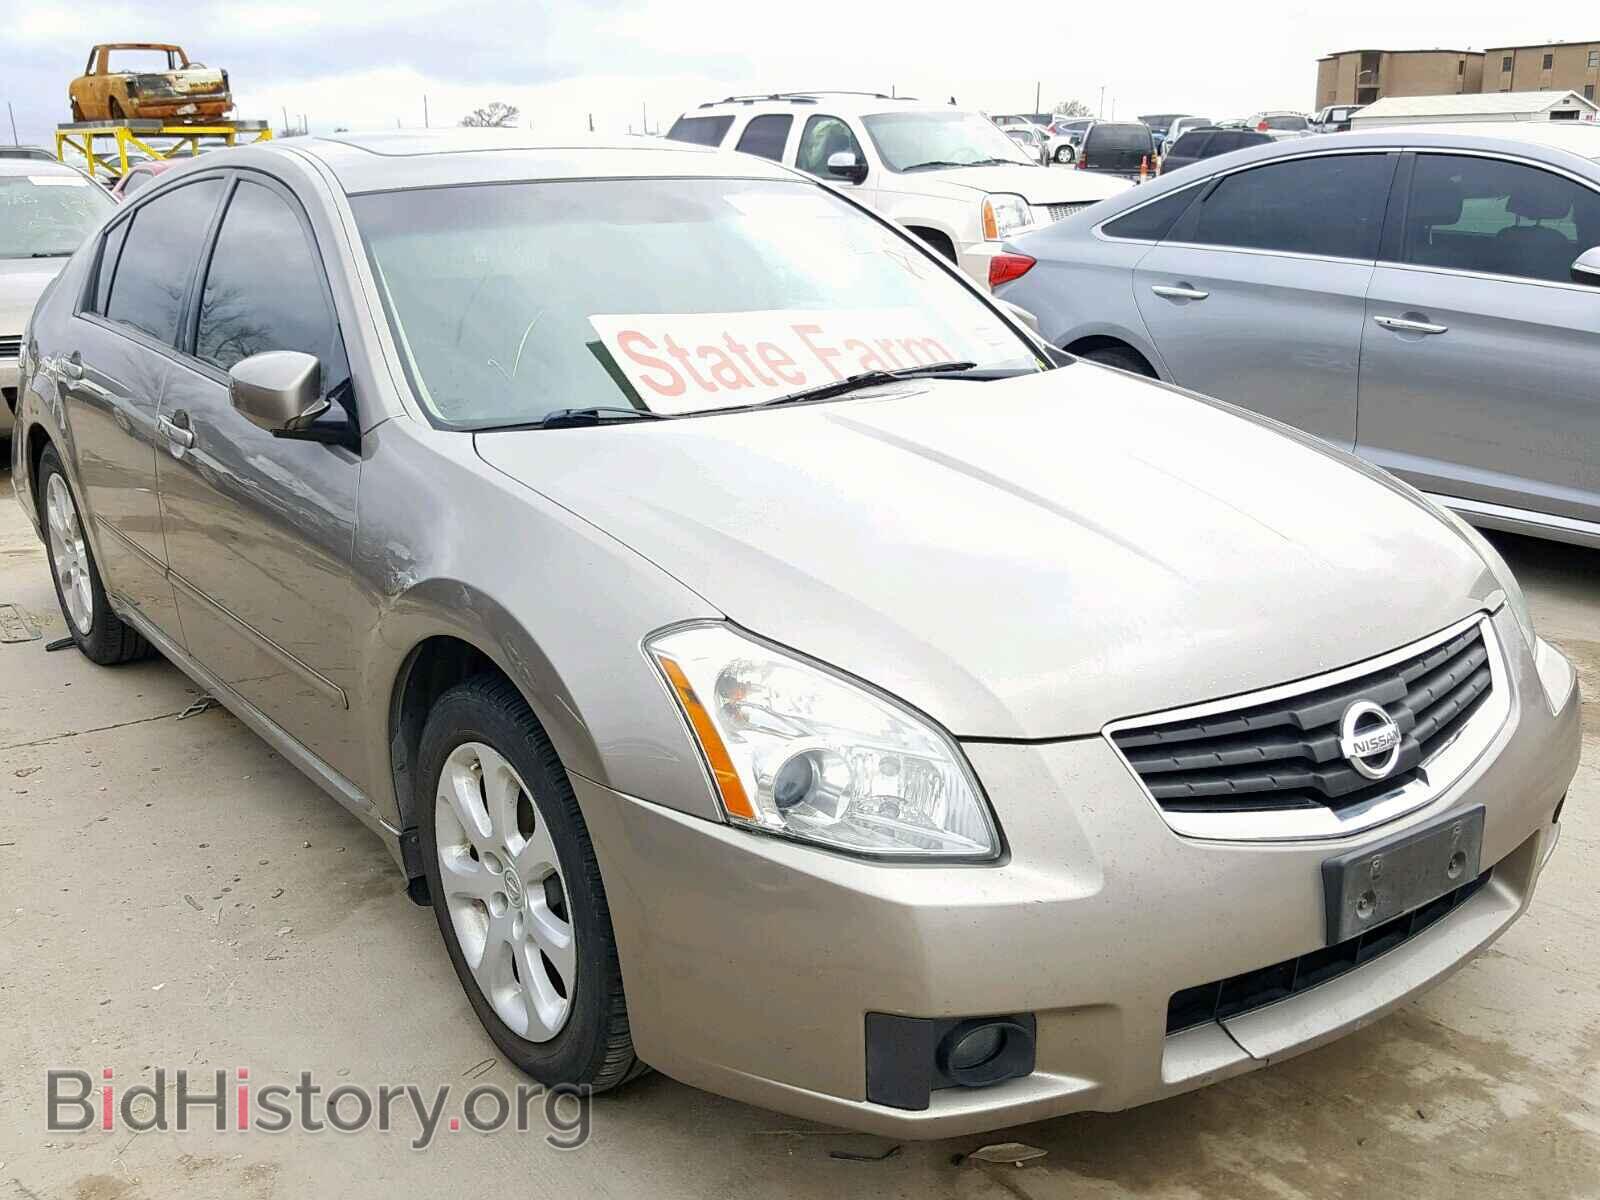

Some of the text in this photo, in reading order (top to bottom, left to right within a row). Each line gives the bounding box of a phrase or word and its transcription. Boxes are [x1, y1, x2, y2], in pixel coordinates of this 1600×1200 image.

[616, 323, 957, 397] State Farm
[1352, 728, 1401, 754] NISSAN
